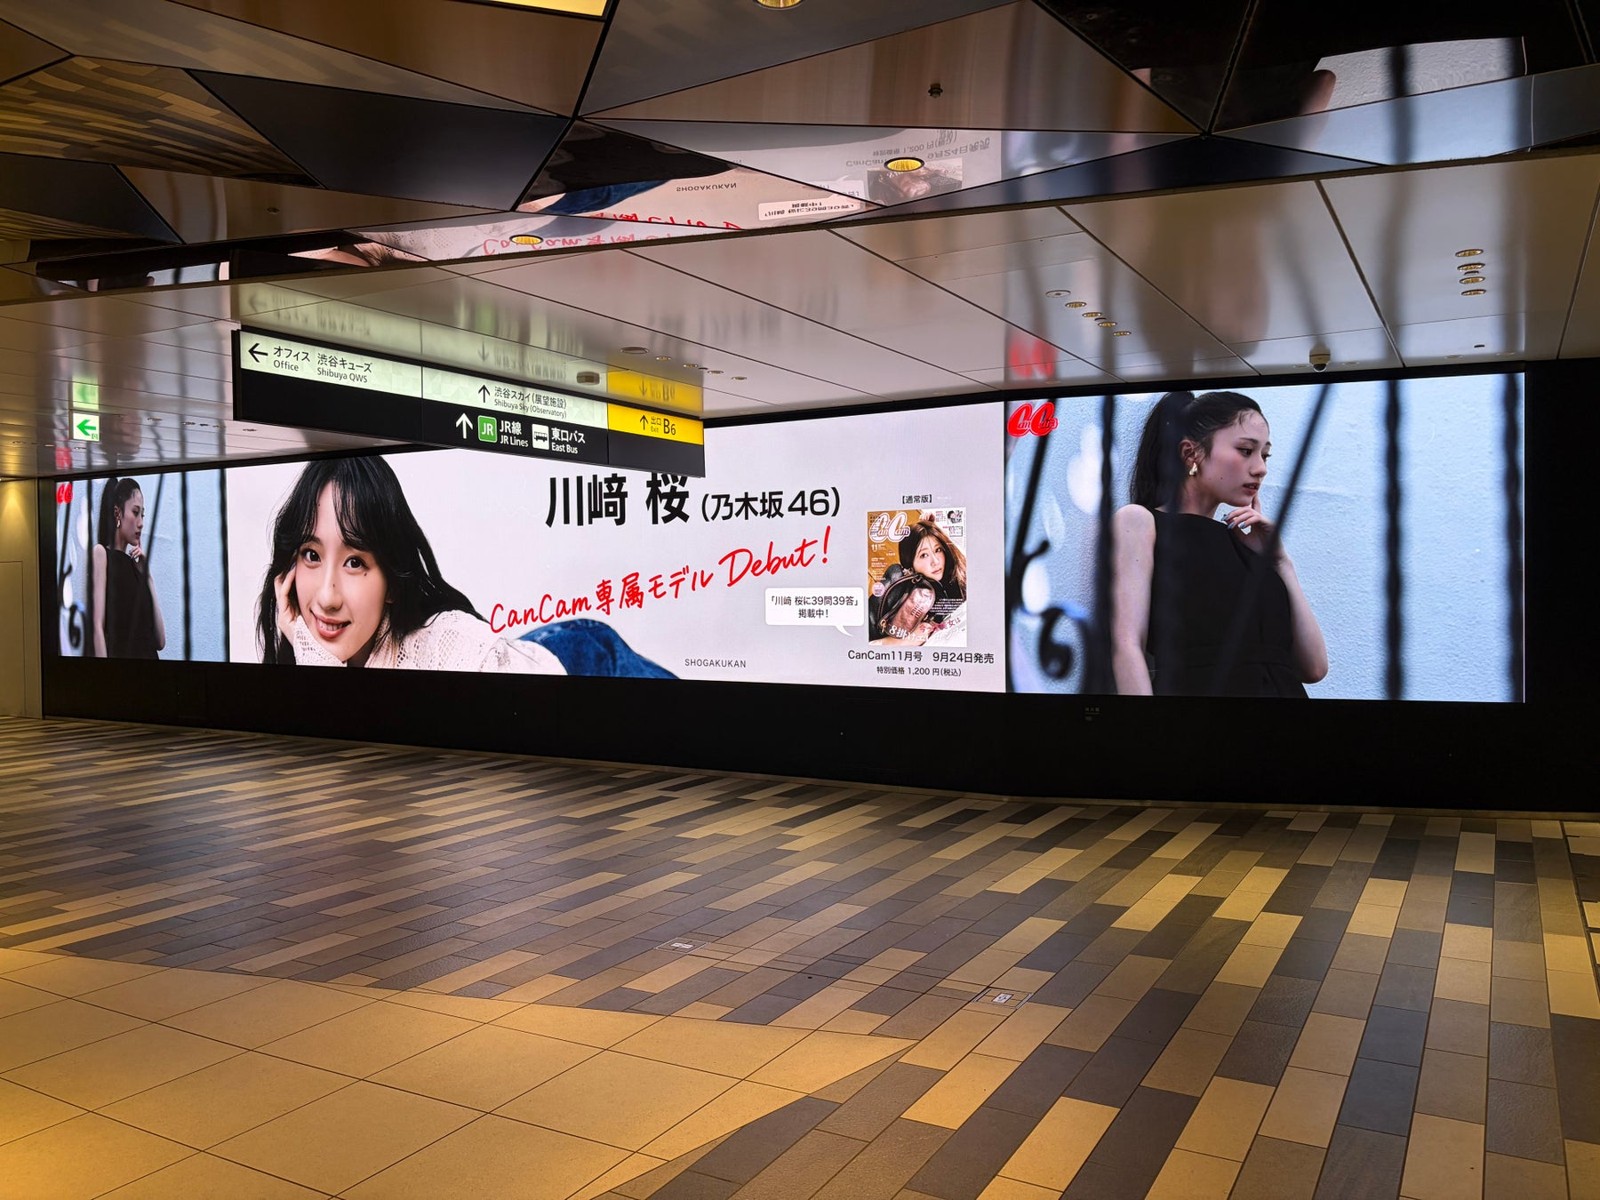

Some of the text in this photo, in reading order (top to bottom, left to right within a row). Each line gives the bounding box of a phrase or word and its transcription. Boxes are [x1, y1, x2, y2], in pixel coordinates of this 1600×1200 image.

[273, 346, 373, 373] オフィス 渋谷キューズ
[273, 359, 368, 383] Office Shibuya QWS
[494, 398, 518, 411] Shibuya
[519, 403, 530, 412] Sky
[481, 422, 494, 436] JR
[499, 420, 522, 435] JR線
[663, 417, 677, 436] B6
[500, 435, 529, 447] JR Lines
[551, 427, 586, 444] 東口バス
[551, 442, 579, 454] East Bus
[645, 472, 690, 525] 桜
[717, 525, 832, 587] Debut!
[684, 658, 747, 669] SHOGAKUKAN
[847, 650, 995, 664] CanCam11月号 9月24日発売
[876, 666, 905, 675] 特別価格
[907, 667, 931, 676] 1,200
